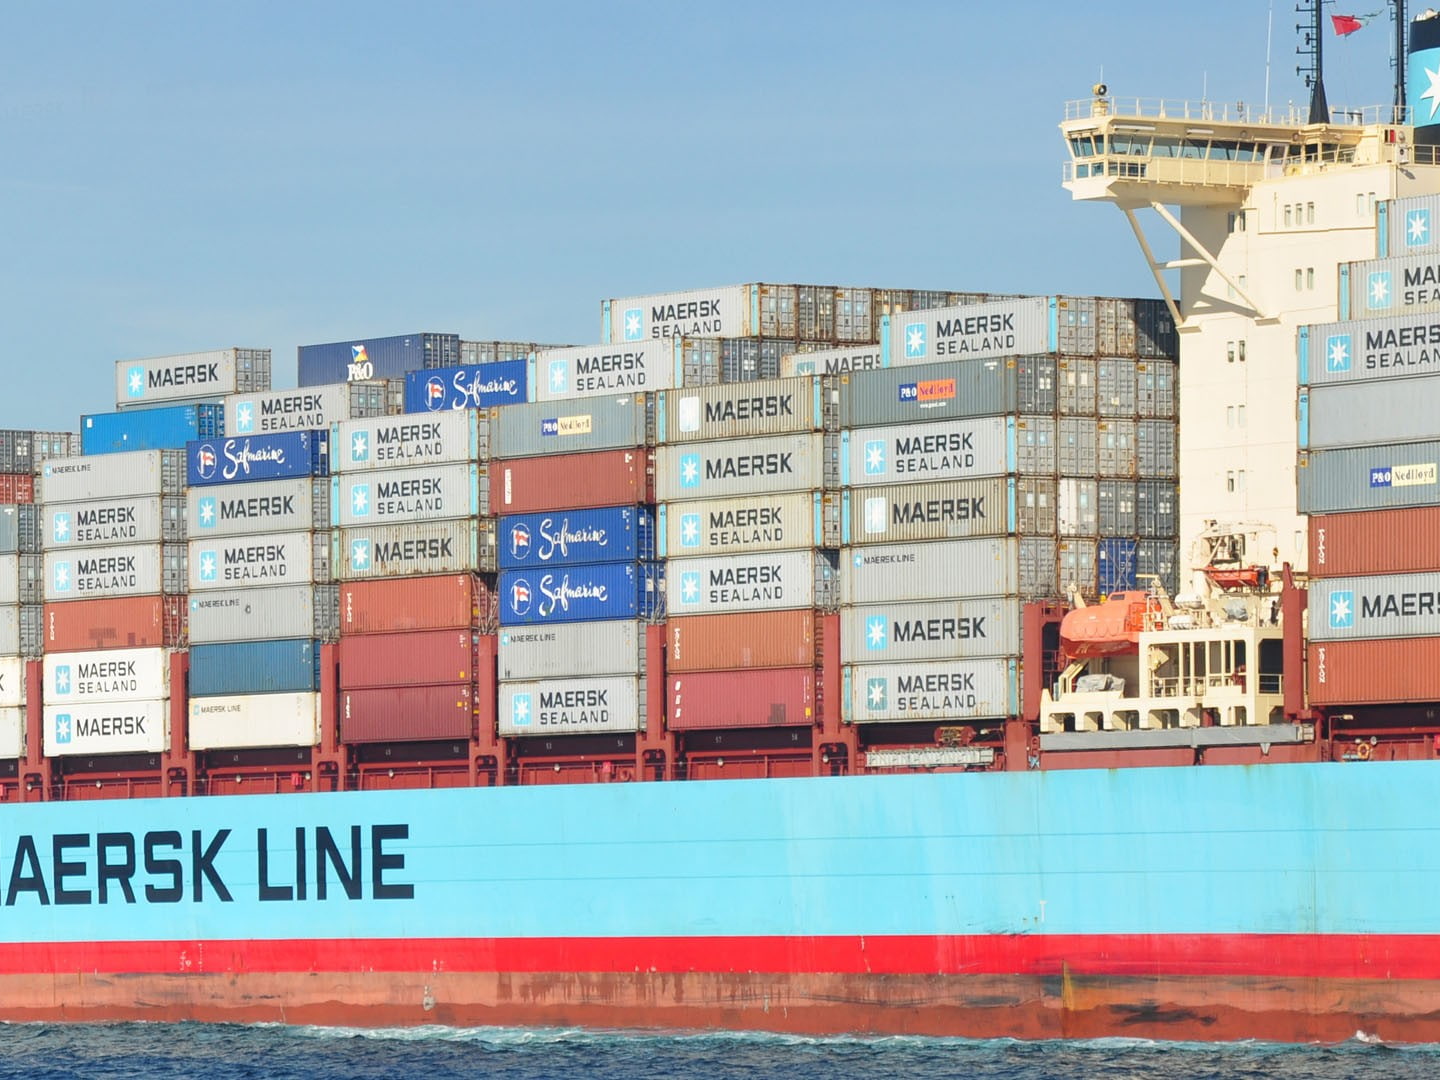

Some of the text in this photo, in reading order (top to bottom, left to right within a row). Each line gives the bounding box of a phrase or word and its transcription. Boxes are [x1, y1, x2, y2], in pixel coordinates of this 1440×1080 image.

[652, 300, 720, 322] MAERSK
[652, 319, 721, 339] SEALAND
[937, 313, 1014, 337] MAERSK
[937, 335, 1015, 355] SEALAND
[348, 362, 373, 382] P&O
[577, 353, 644, 374] MAERSK
[826, 355, 880, 376] MAERS
[148, 364, 218, 388] MAERSK
[577, 373, 646, 391] SEALAND
[452, 371, 518, 410] Safmarine
[901, 386, 917, 398] P&O
[262, 395, 322, 415] MAERSK
[706, 395, 792, 422] MAERSK
[262, 414, 323, 430] SEALAND
[377, 423, 441, 443] MAERSK
[378, 443, 442, 460] SEALAND
[896, 432, 973, 455] MAERSK
[223, 440, 285, 479] Safmarine
[706, 453, 792, 480] MAERSK
[896, 454, 974, 472] SEALAND
[1372, 465, 1435, 484] P&O Nedlloyd
[378, 478, 441, 498] MAERSK
[77, 507, 135, 526] MAERSK
[220, 496, 294, 519] MAERSK
[378, 498, 442, 515] SEALAND
[893, 498, 986, 524] MAERSK
[710, 507, 782, 528] MAERSK
[78, 526, 136, 541] SEALAND
[539, 519, 608, 559] Safmarine
[710, 528, 783, 546] SEALAND
[224, 546, 285, 564] MAERSK
[375, 538, 452, 562] MAERSK
[78, 557, 136, 575] MAERSK
[225, 564, 286, 580] SEALAND
[710, 566, 782, 586] MAERSK
[78, 575, 136, 590] SEALAND
[539, 576, 608, 616] Safmarine
[710, 586, 783, 603] SEALAND
[894, 617, 986, 642] MAERSK
[78, 661, 136, 678] MAERSK
[78, 680, 137, 694] SEALAND
[898, 673, 974, 692] MAERSK
[540, 690, 608, 708] MAERSK
[898, 695, 976, 710] SEALAND
[76, 716, 145, 737] MAERSK
[540, 711, 608, 724] SEALAND
[257, 824, 414, 902] LINE
